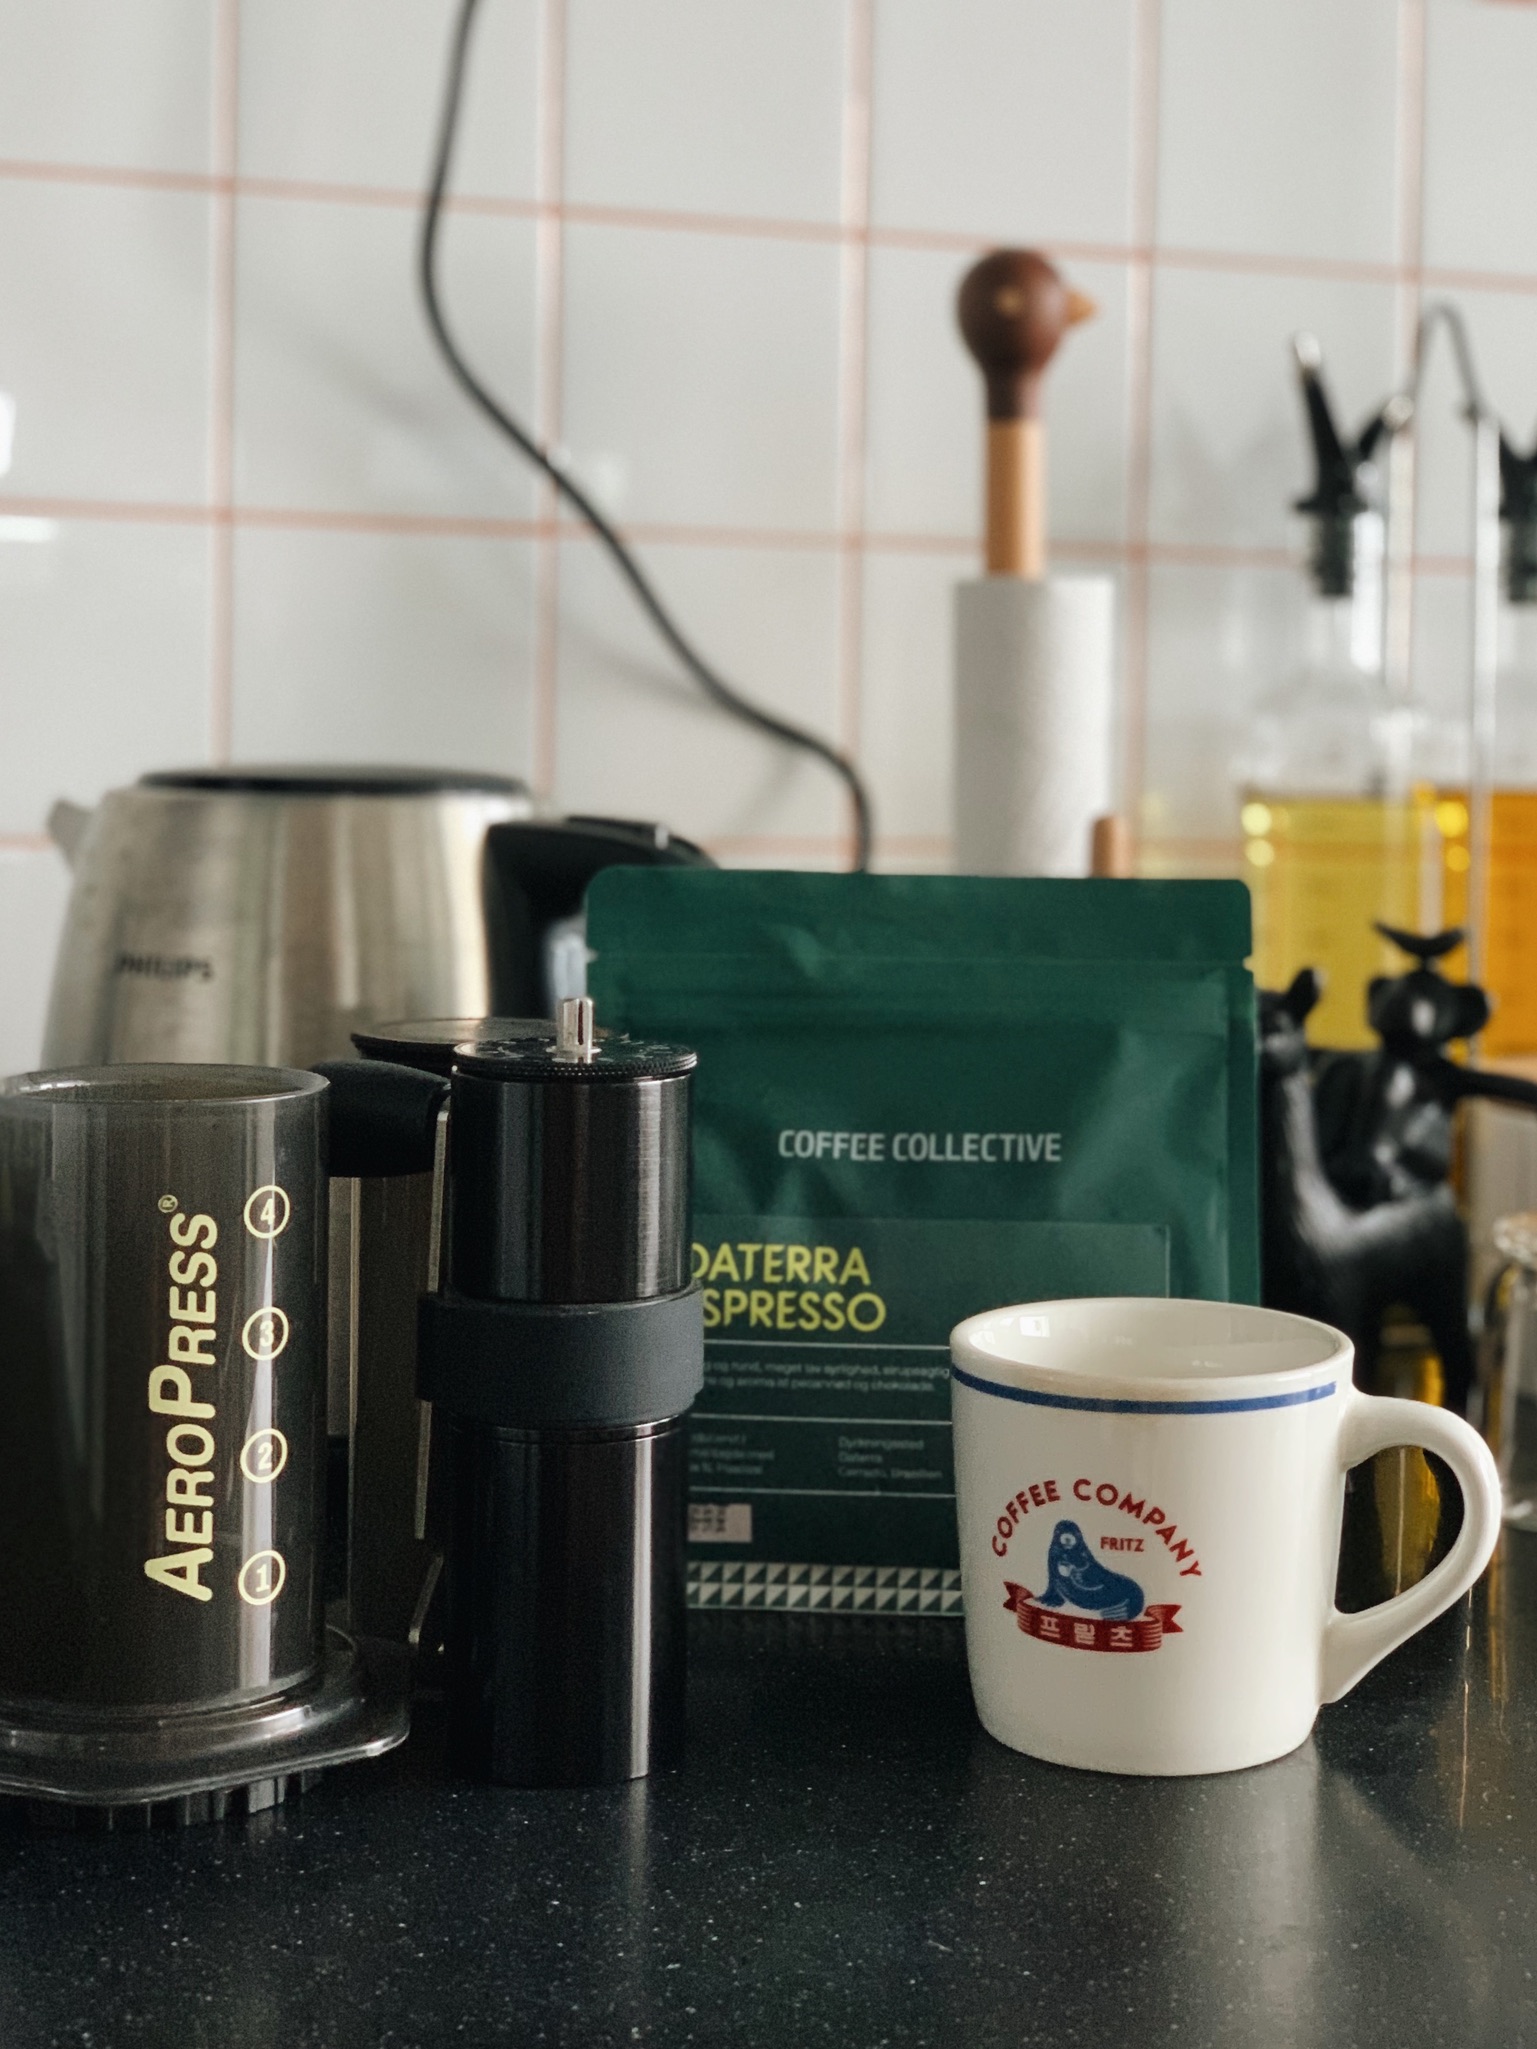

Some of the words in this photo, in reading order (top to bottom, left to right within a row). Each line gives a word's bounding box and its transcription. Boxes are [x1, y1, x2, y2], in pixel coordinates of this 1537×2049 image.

[778, 1130, 885, 1161] COFFEE
[892, 1133, 1061, 1162] COLLECTIVE
[702, 1288, 886, 1332] SPRESSO
[992, 1480, 1061, 1558] COFFEE
[1073, 1479, 1202, 1577] COMPANY
[1100, 1536, 1145, 1552] FRITZ
